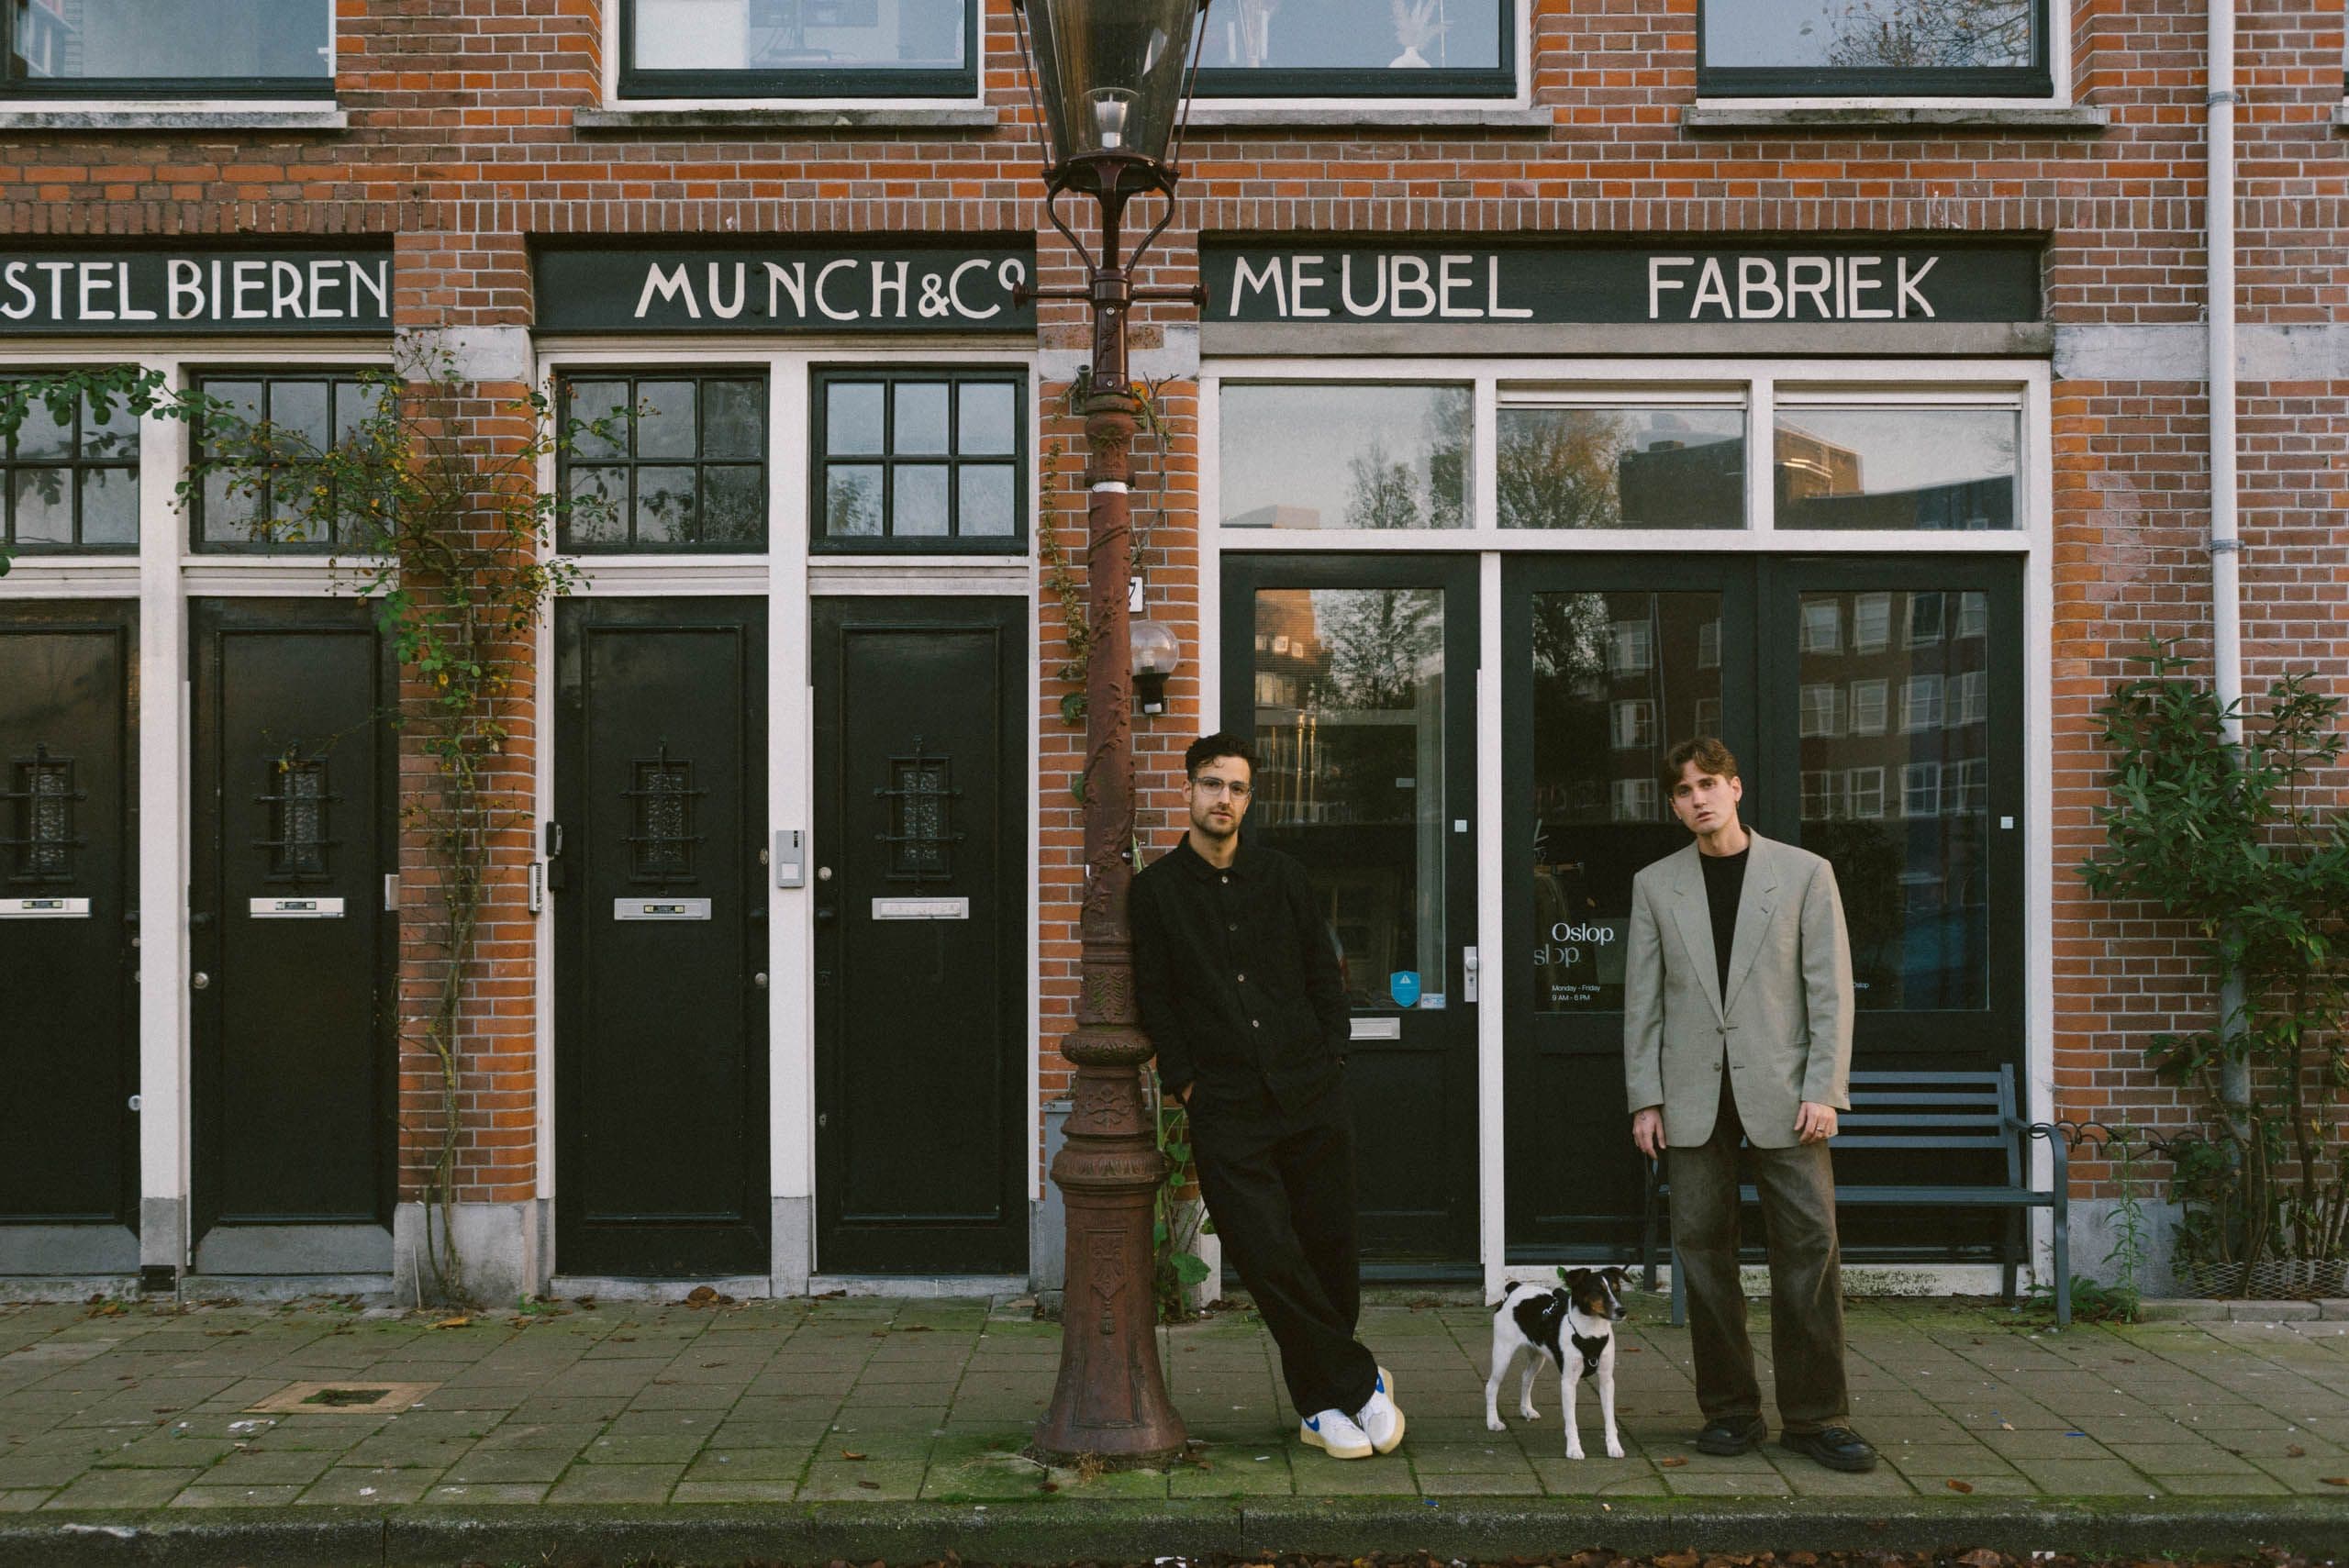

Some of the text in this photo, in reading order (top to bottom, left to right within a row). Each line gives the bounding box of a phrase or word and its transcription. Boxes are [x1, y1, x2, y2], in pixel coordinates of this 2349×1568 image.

[168, 259, 389, 320] BIEREN
[1229, 254, 1939, 319] MEUBEL FABRIEK
[1552, 984, 1576, 993] Monday
[1581, 984, 1601, 993] Friday
